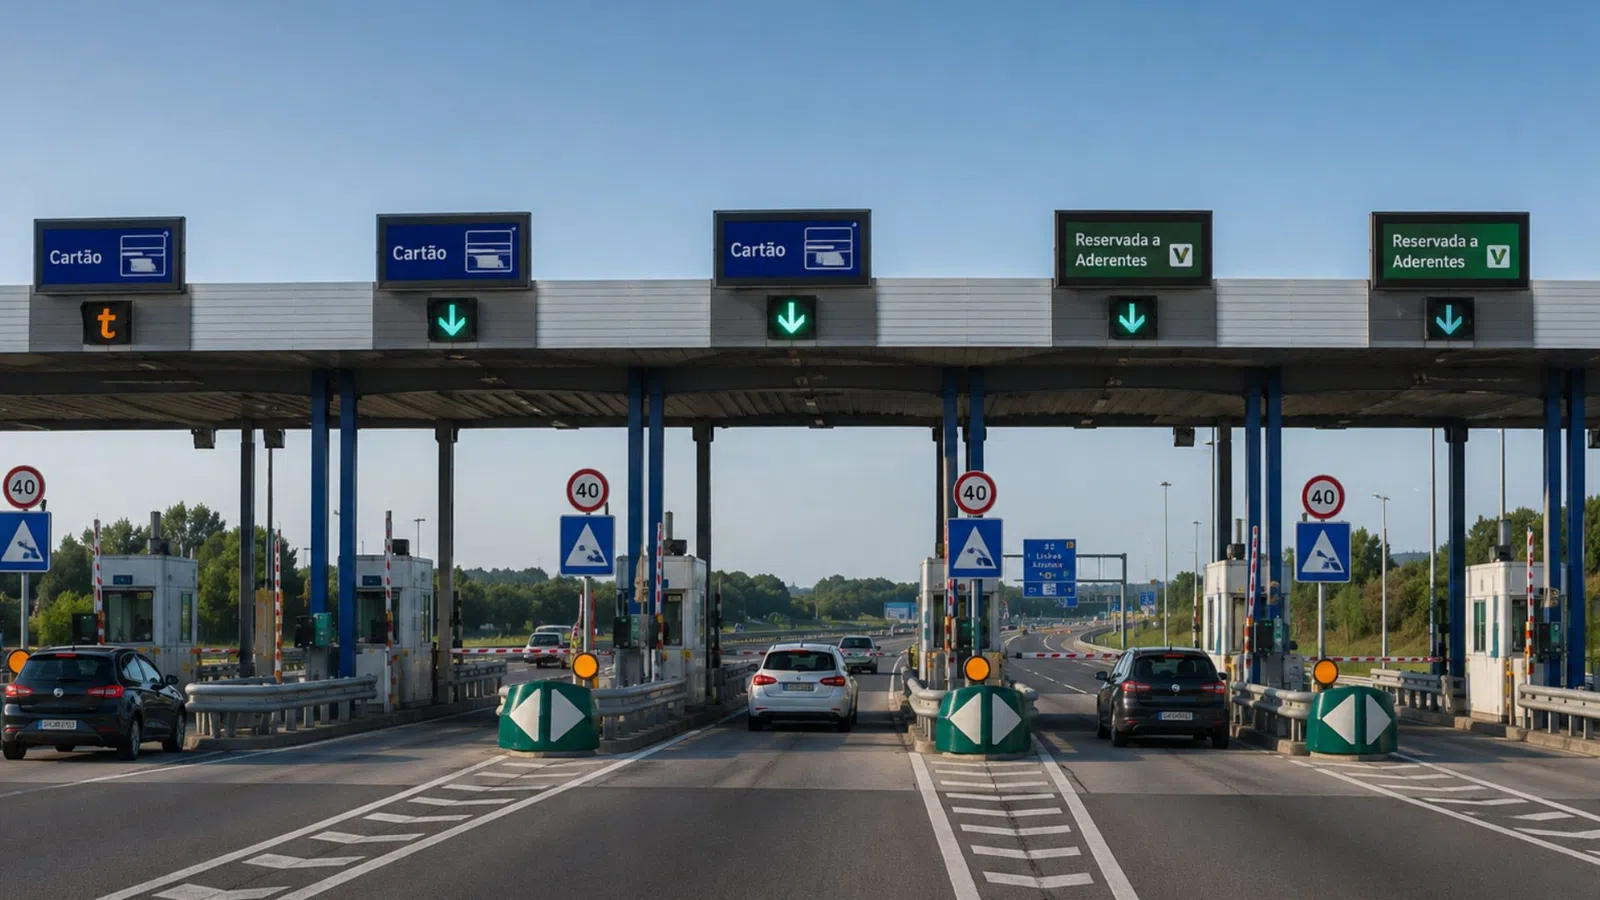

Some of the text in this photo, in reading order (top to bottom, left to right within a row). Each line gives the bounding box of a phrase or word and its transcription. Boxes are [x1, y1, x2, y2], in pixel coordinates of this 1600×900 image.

[1075, 233, 1161, 246] Reservada a
[1392, 234, 1478, 247] Reservada a
[49, 249, 102, 266] Cartão
[393, 244, 447, 261] Cartão
[731, 242, 786, 257] Cartão
[1075, 253, 1147, 266] Aderentes
[1392, 255, 1465, 268] Aderentes
[96, 307, 116, 339] t
[12, 479, 35, 495] 40
[576, 482, 599, 498] 40
[963, 485, 987, 501] 40
[1311, 489, 1335, 505] 40
